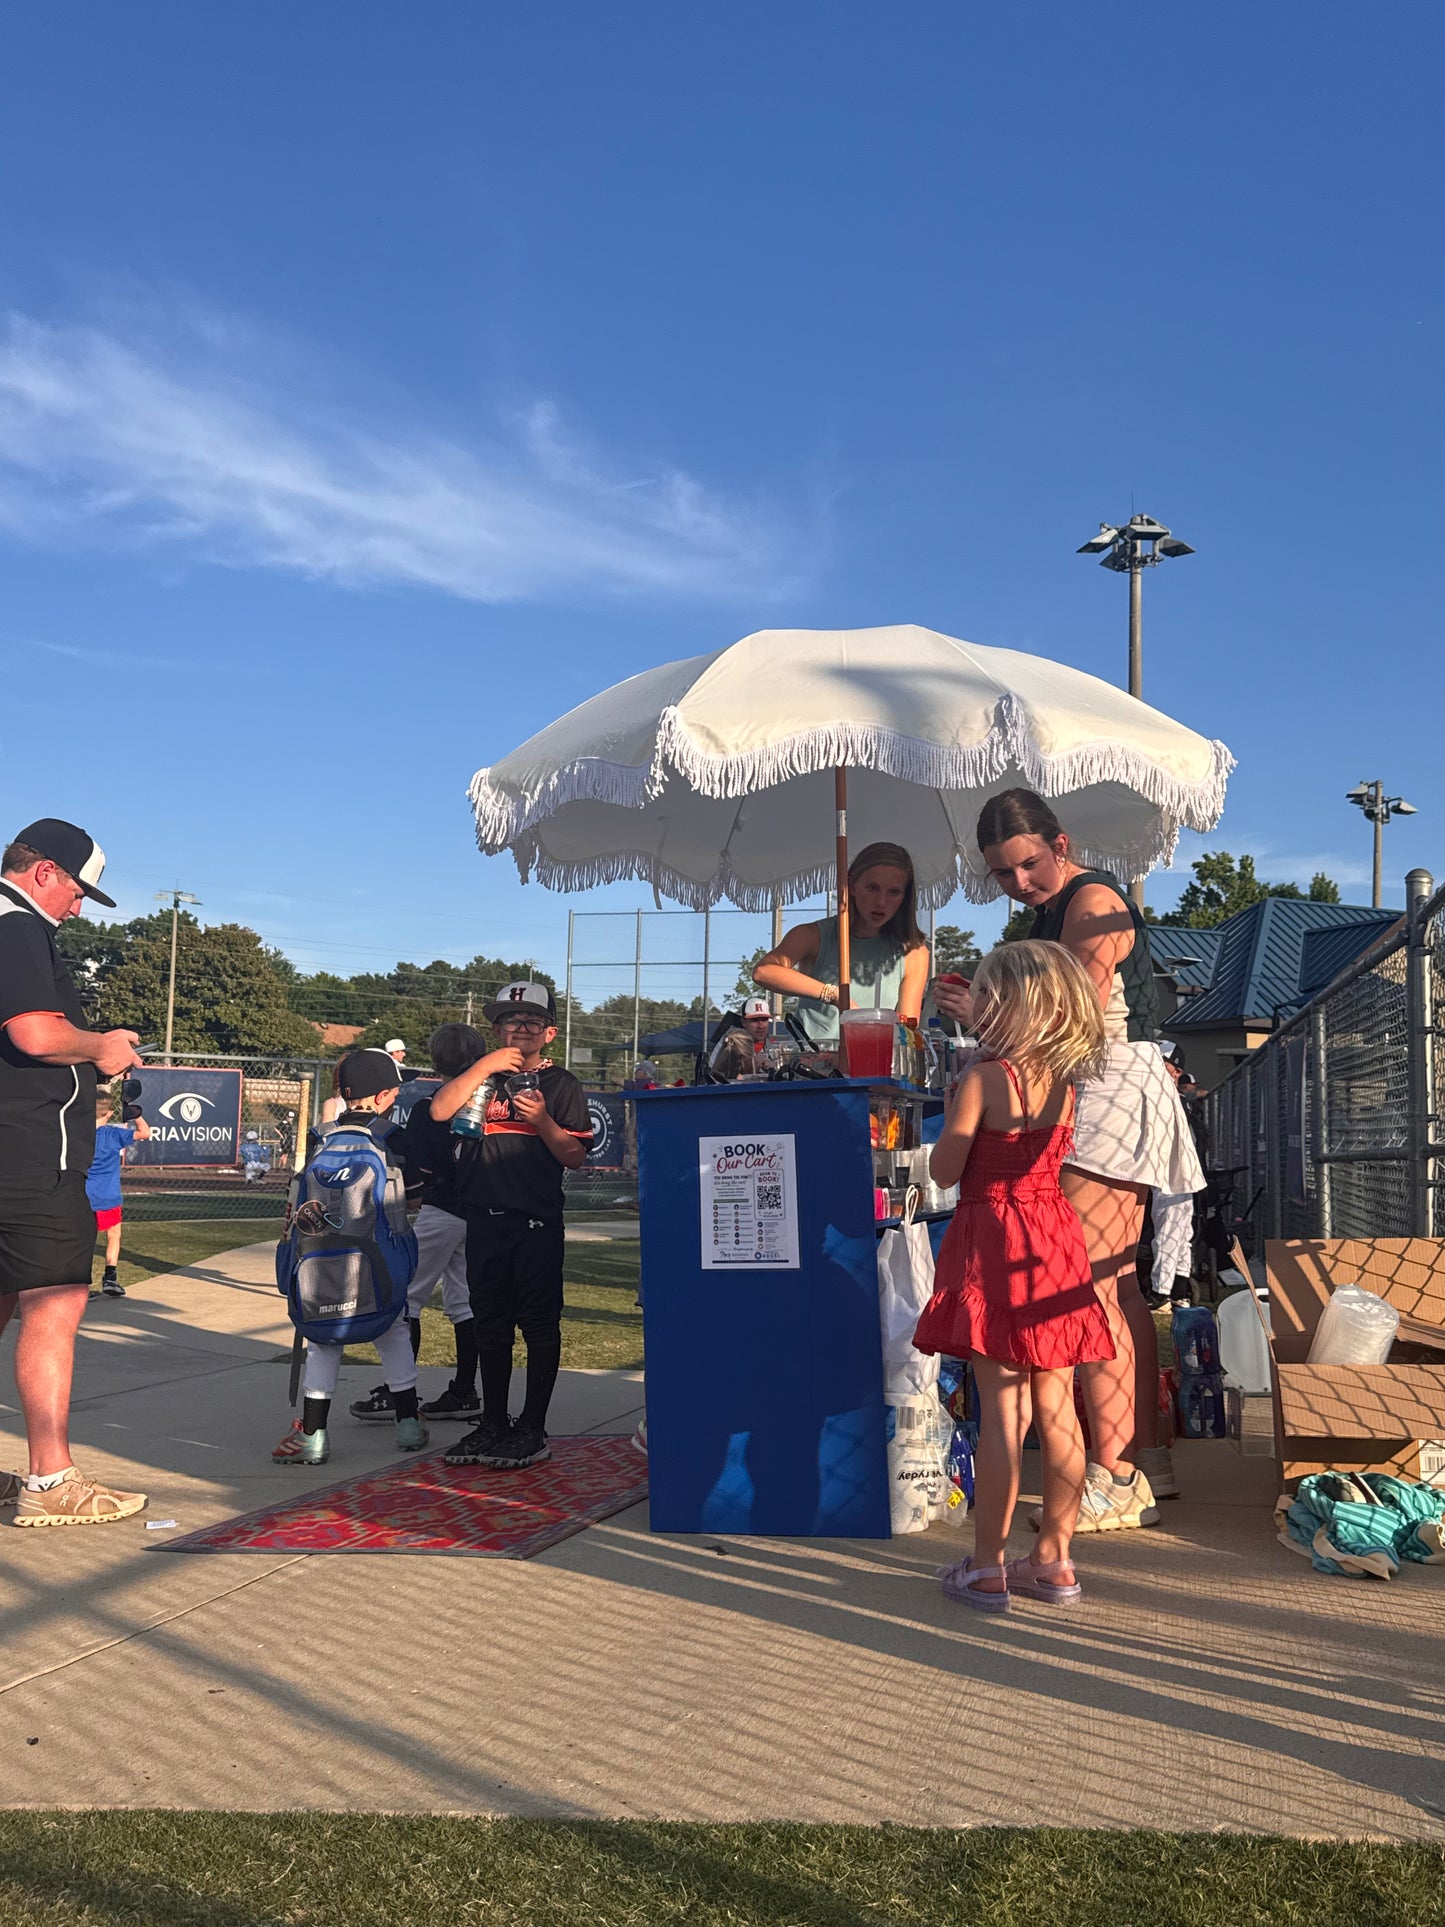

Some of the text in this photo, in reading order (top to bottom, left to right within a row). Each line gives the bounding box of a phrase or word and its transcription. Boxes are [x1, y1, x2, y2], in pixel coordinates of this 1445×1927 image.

[140, 1126, 233, 1142] RIAVISION
[724, 1144, 765, 1158] BOOK
[717, 1153, 777, 1174] Our Cart
[319, 1298, 357, 1314] marucci
